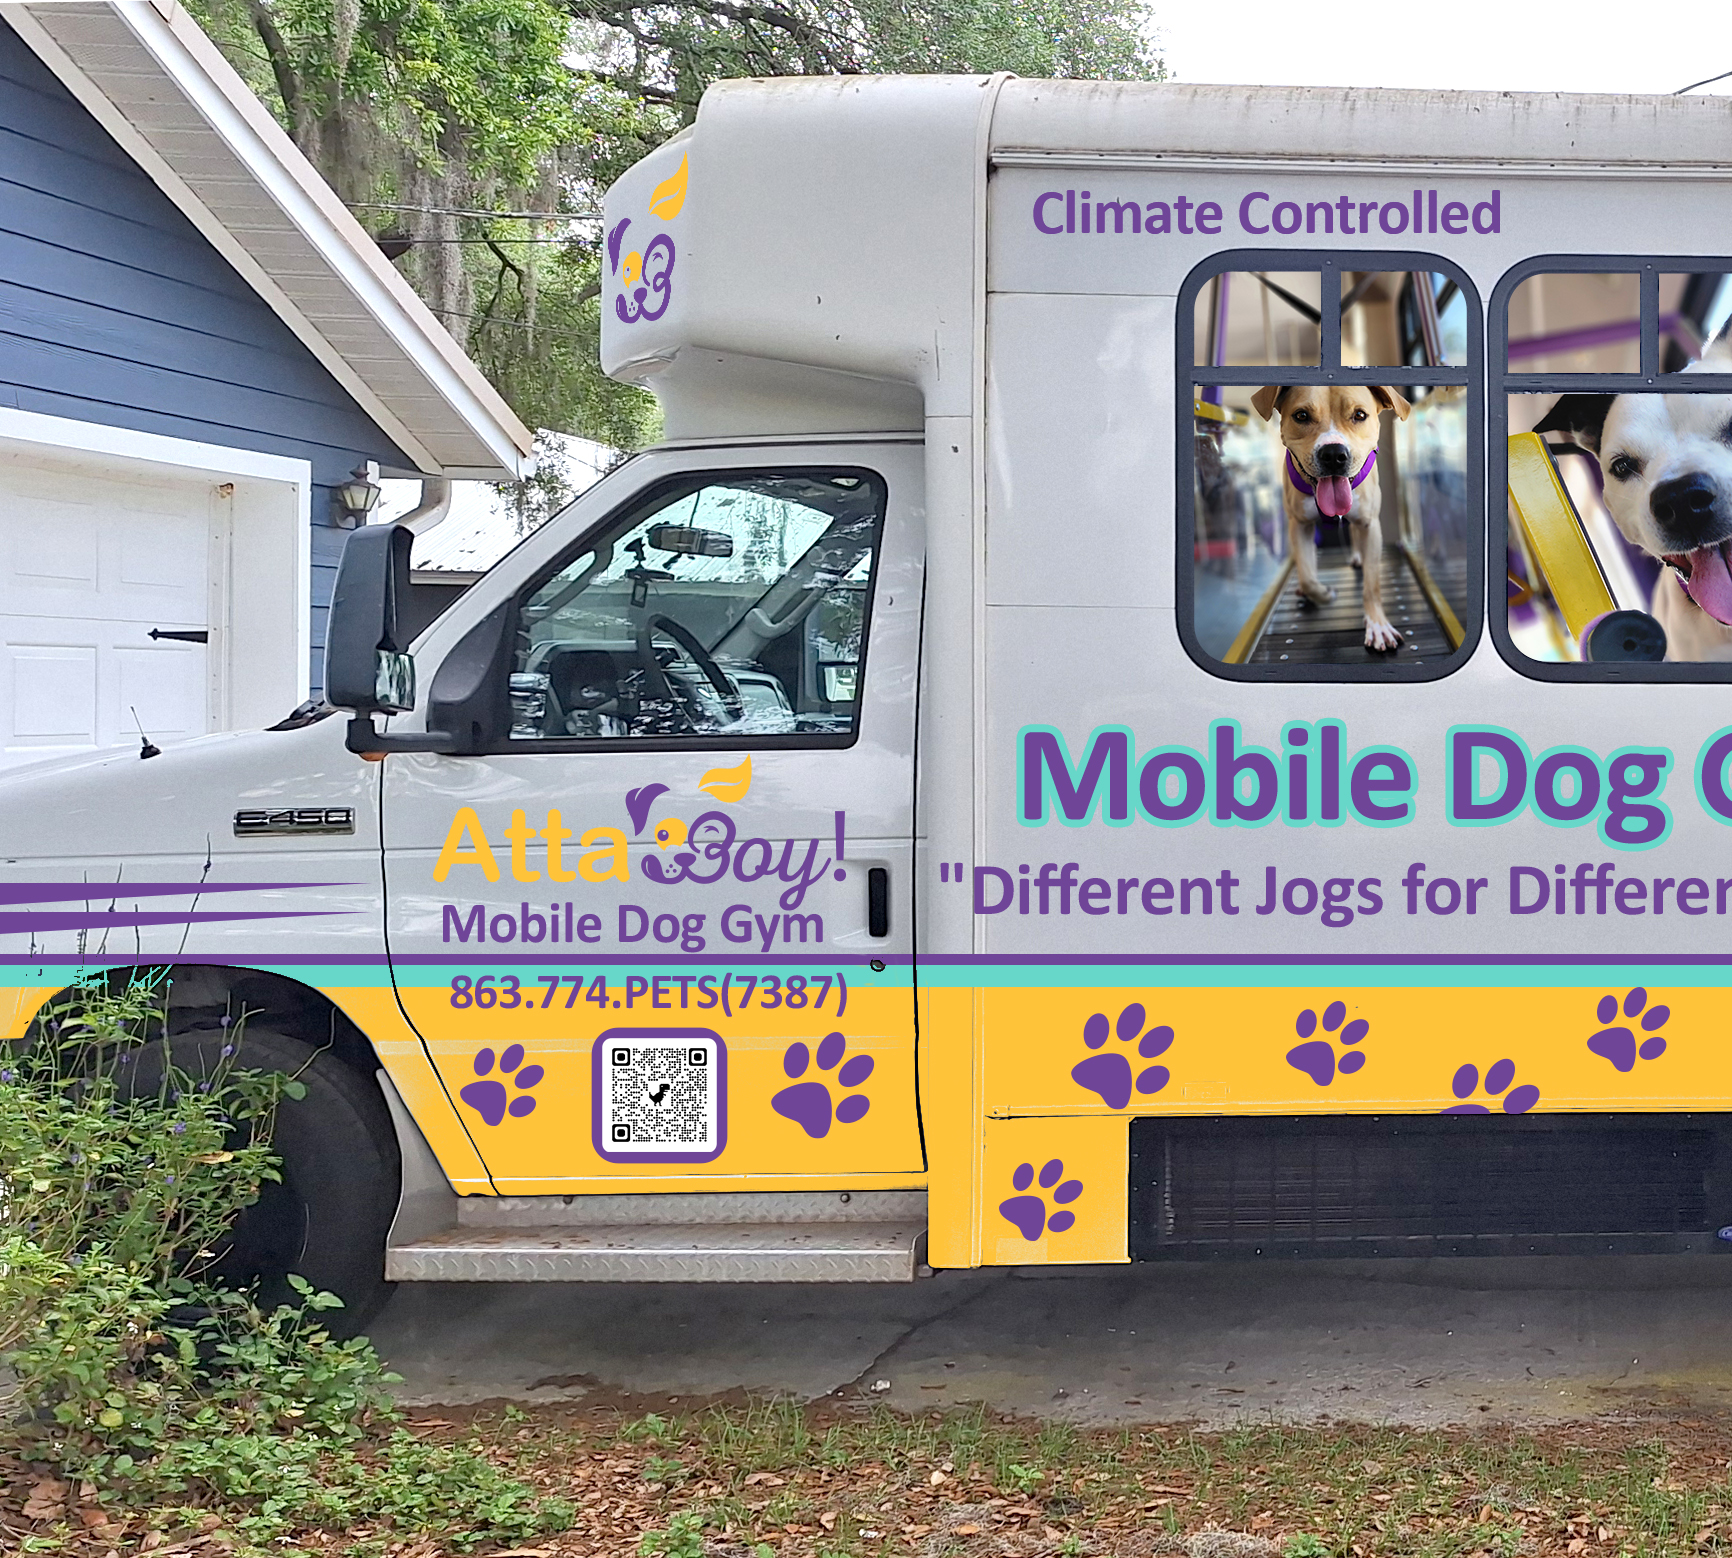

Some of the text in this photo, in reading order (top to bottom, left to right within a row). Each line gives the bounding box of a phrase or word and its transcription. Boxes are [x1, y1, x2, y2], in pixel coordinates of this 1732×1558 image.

[1032, 189, 1502, 235] Climate Controlled
[1022, 724, 1412, 822] Mobile
[1450, 729, 1668, 845] Dog
[432, 806, 847, 910] Atta Boy!
[939, 862, 1239, 916] "Different
[1256, 865, 1384, 928] Jogs
[1401, 862, 1489, 916] for
[442, 901, 824, 953] Mobile Dog Gym
[450, 973, 848, 1018] 863.774.PETS(7387)
